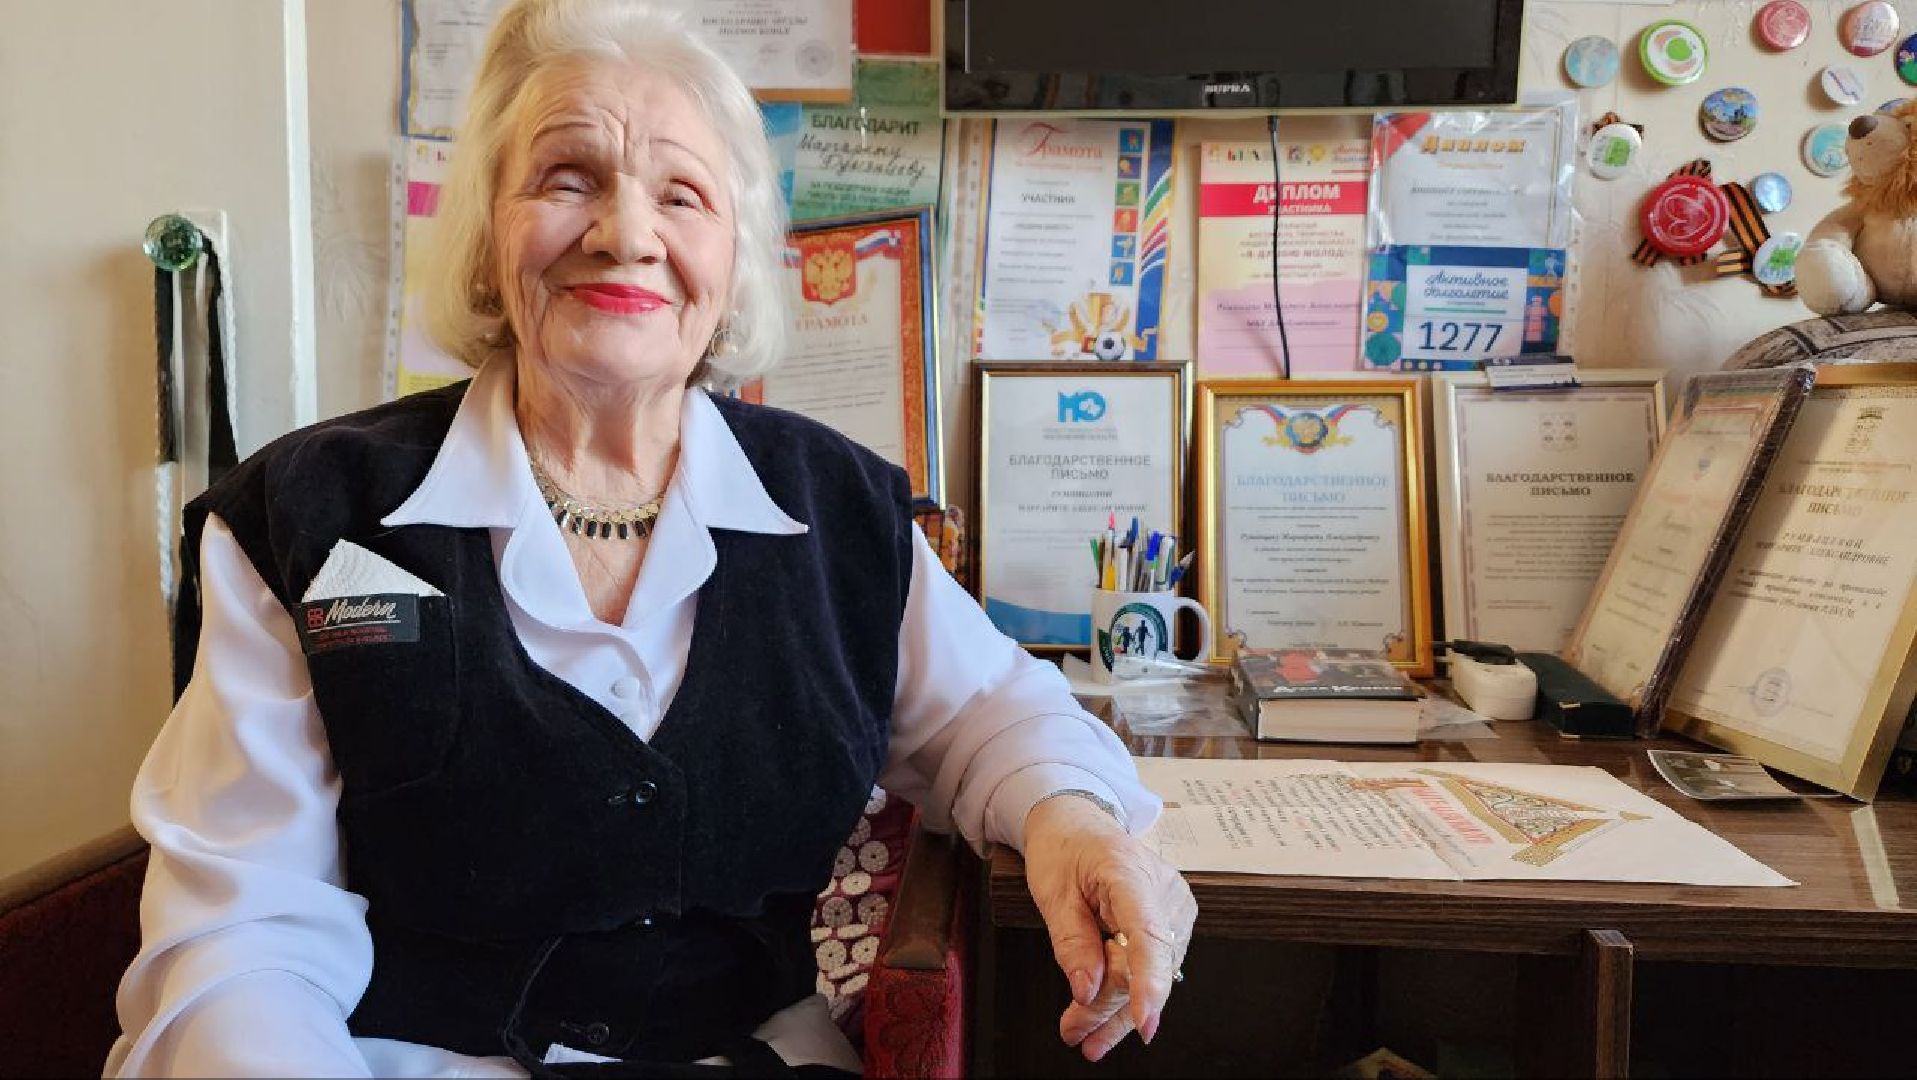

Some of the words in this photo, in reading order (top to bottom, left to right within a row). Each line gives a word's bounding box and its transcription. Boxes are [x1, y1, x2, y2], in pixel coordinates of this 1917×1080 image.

[812, 112, 920, 135] БЛАГОДАРИТ
[1421, 134, 1526, 154] Диплом
[1253, 183, 1341, 203] ДИПЛОМ
[1267, 203, 1332, 214] УАСТНИКА
[1418, 321, 1503, 352] 1277
[1009, 454, 1151, 468] БЛАГОДАРСТВЕННОЕ
[1051, 468, 1109, 480] ПИСЬМО
[1236, 473, 1388, 488] БЛАГОДАРСТВЕННОЕ
[1486, 472, 1635, 484] БЛАГОДАРСТВЕННОЕ
[1282, 491, 1346, 504] ПИСЬМО
[1530, 487, 1591, 496] ПИСЬМО
[324, 596, 397, 625] Modern
